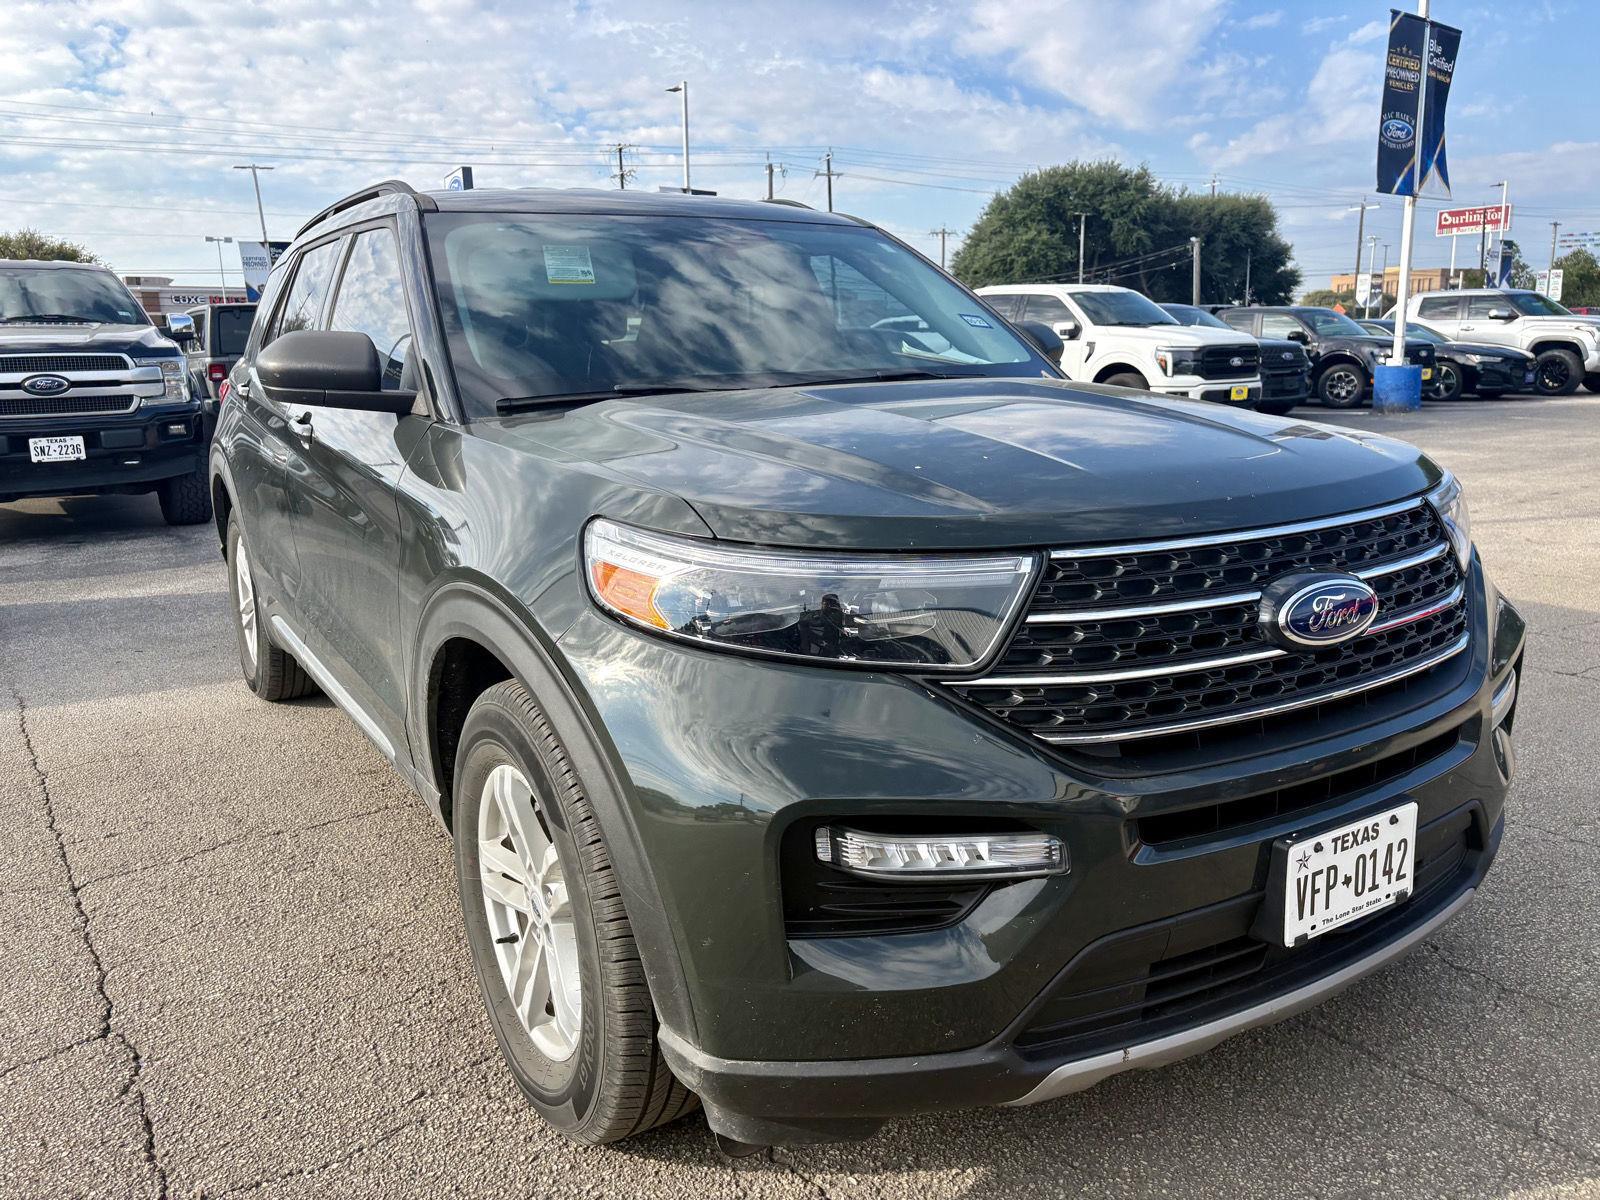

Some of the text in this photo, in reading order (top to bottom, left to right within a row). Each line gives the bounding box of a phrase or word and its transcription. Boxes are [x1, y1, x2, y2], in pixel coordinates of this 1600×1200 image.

[1429, 39, 1442, 54] Blue
[1388, 53, 1420, 70] CERTIFIED
[1387, 65, 1420, 82] PREOWNED
[1387, 122, 1408, 138] Ford
[171, 295, 206, 304] LUXE
[36, 380, 58, 389] Ford
[1309, 593, 1361, 632] Ford
[1331, 822, 1380, 855] TEXAS
[1322, 897, 1382, 926] The Lone Star State
